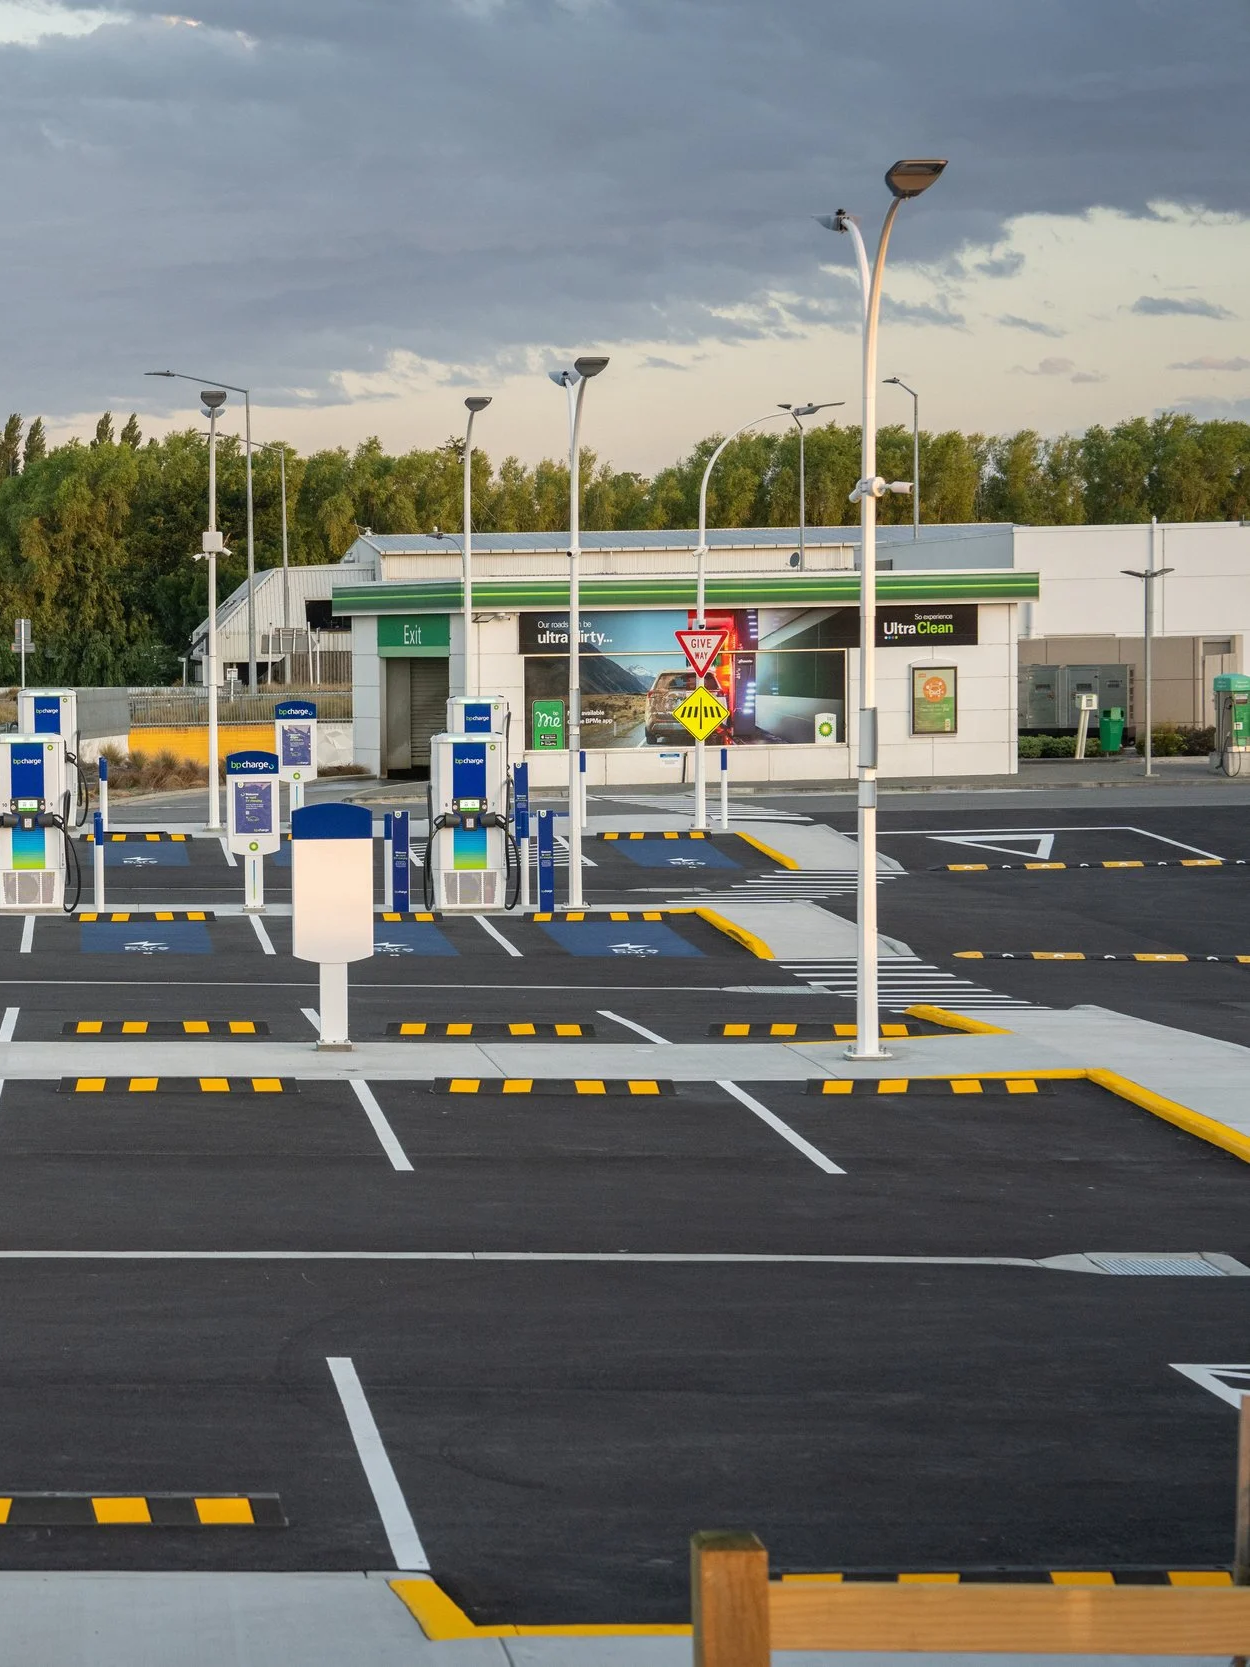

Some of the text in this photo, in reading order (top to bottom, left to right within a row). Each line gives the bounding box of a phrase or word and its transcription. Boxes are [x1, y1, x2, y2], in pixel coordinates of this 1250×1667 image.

[404, 624, 422, 645] Exit
[538, 630, 613, 646] ultra irty...
[691, 638, 712, 648] GIVE
